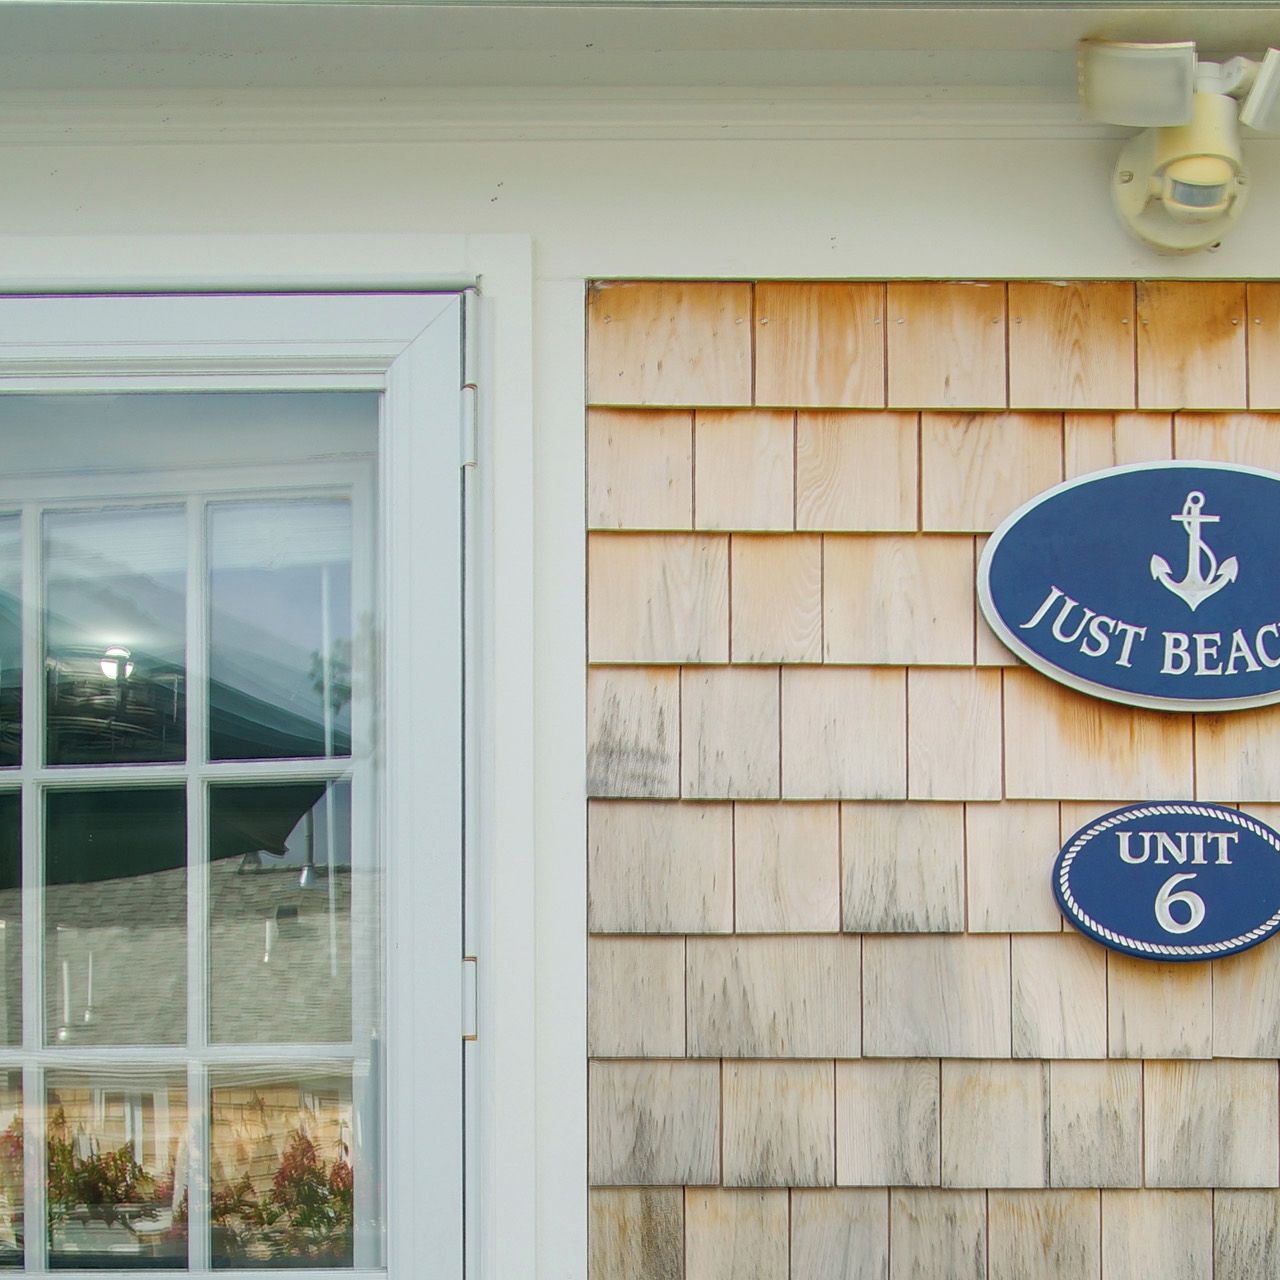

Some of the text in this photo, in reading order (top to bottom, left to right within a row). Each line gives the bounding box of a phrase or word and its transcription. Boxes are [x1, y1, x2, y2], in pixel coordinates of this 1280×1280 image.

[1020, 585, 1147, 668] JUST
[1115, 831, 1239, 865] UNIT
[1154, 872, 1206, 935] 6
